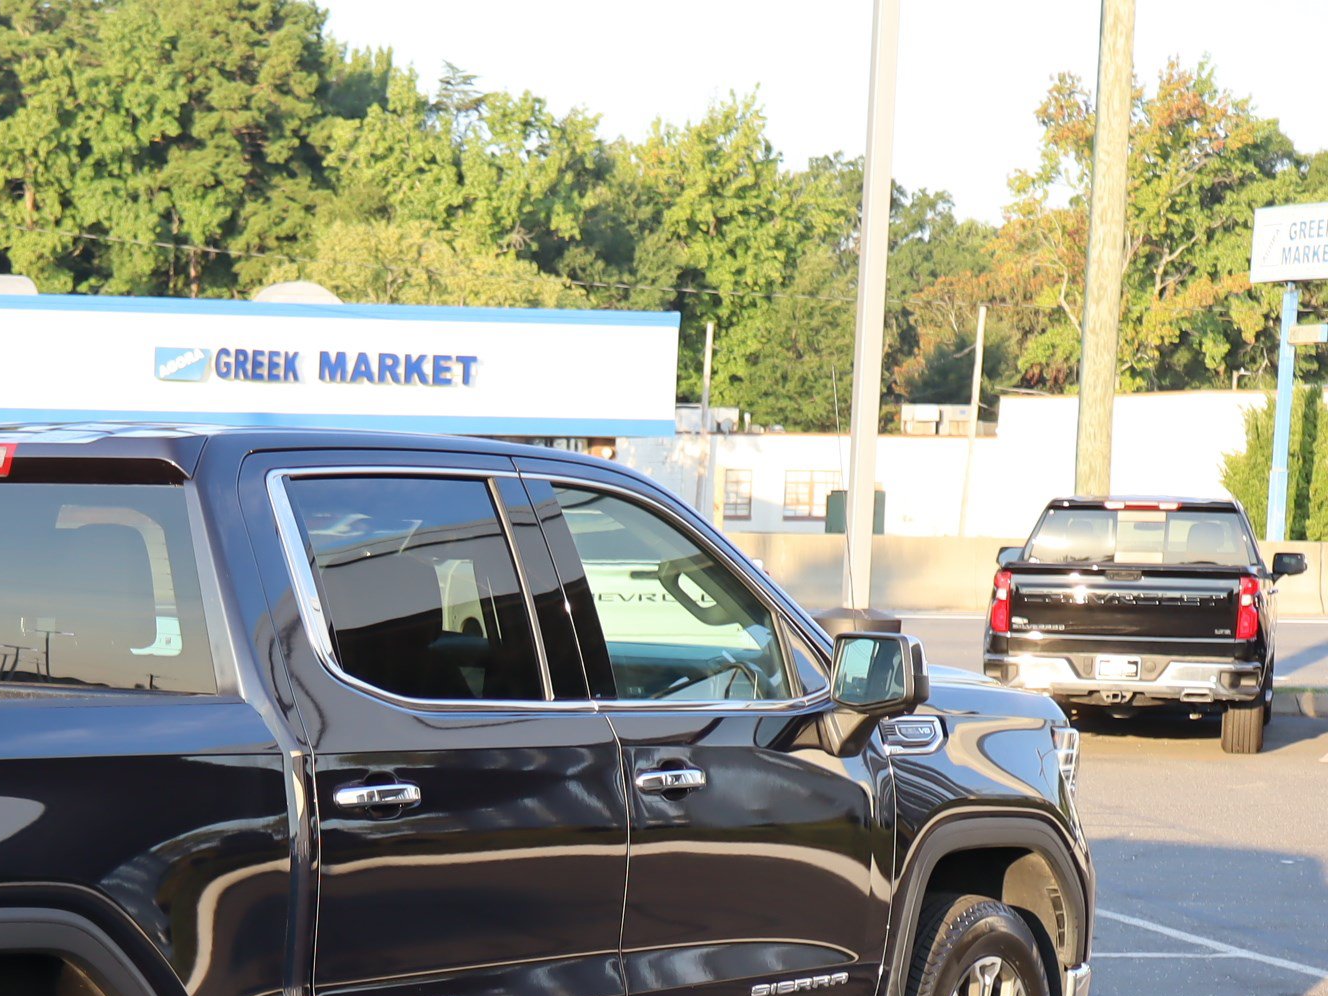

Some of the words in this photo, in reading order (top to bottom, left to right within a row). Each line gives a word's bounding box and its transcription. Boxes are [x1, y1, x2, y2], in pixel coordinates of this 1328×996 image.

[1289, 219, 1328, 240] GREE
[214, 348, 300, 381] GREEK
[318, 351, 478, 385] MARKET
[751, 971, 849, 996] SIERRA
